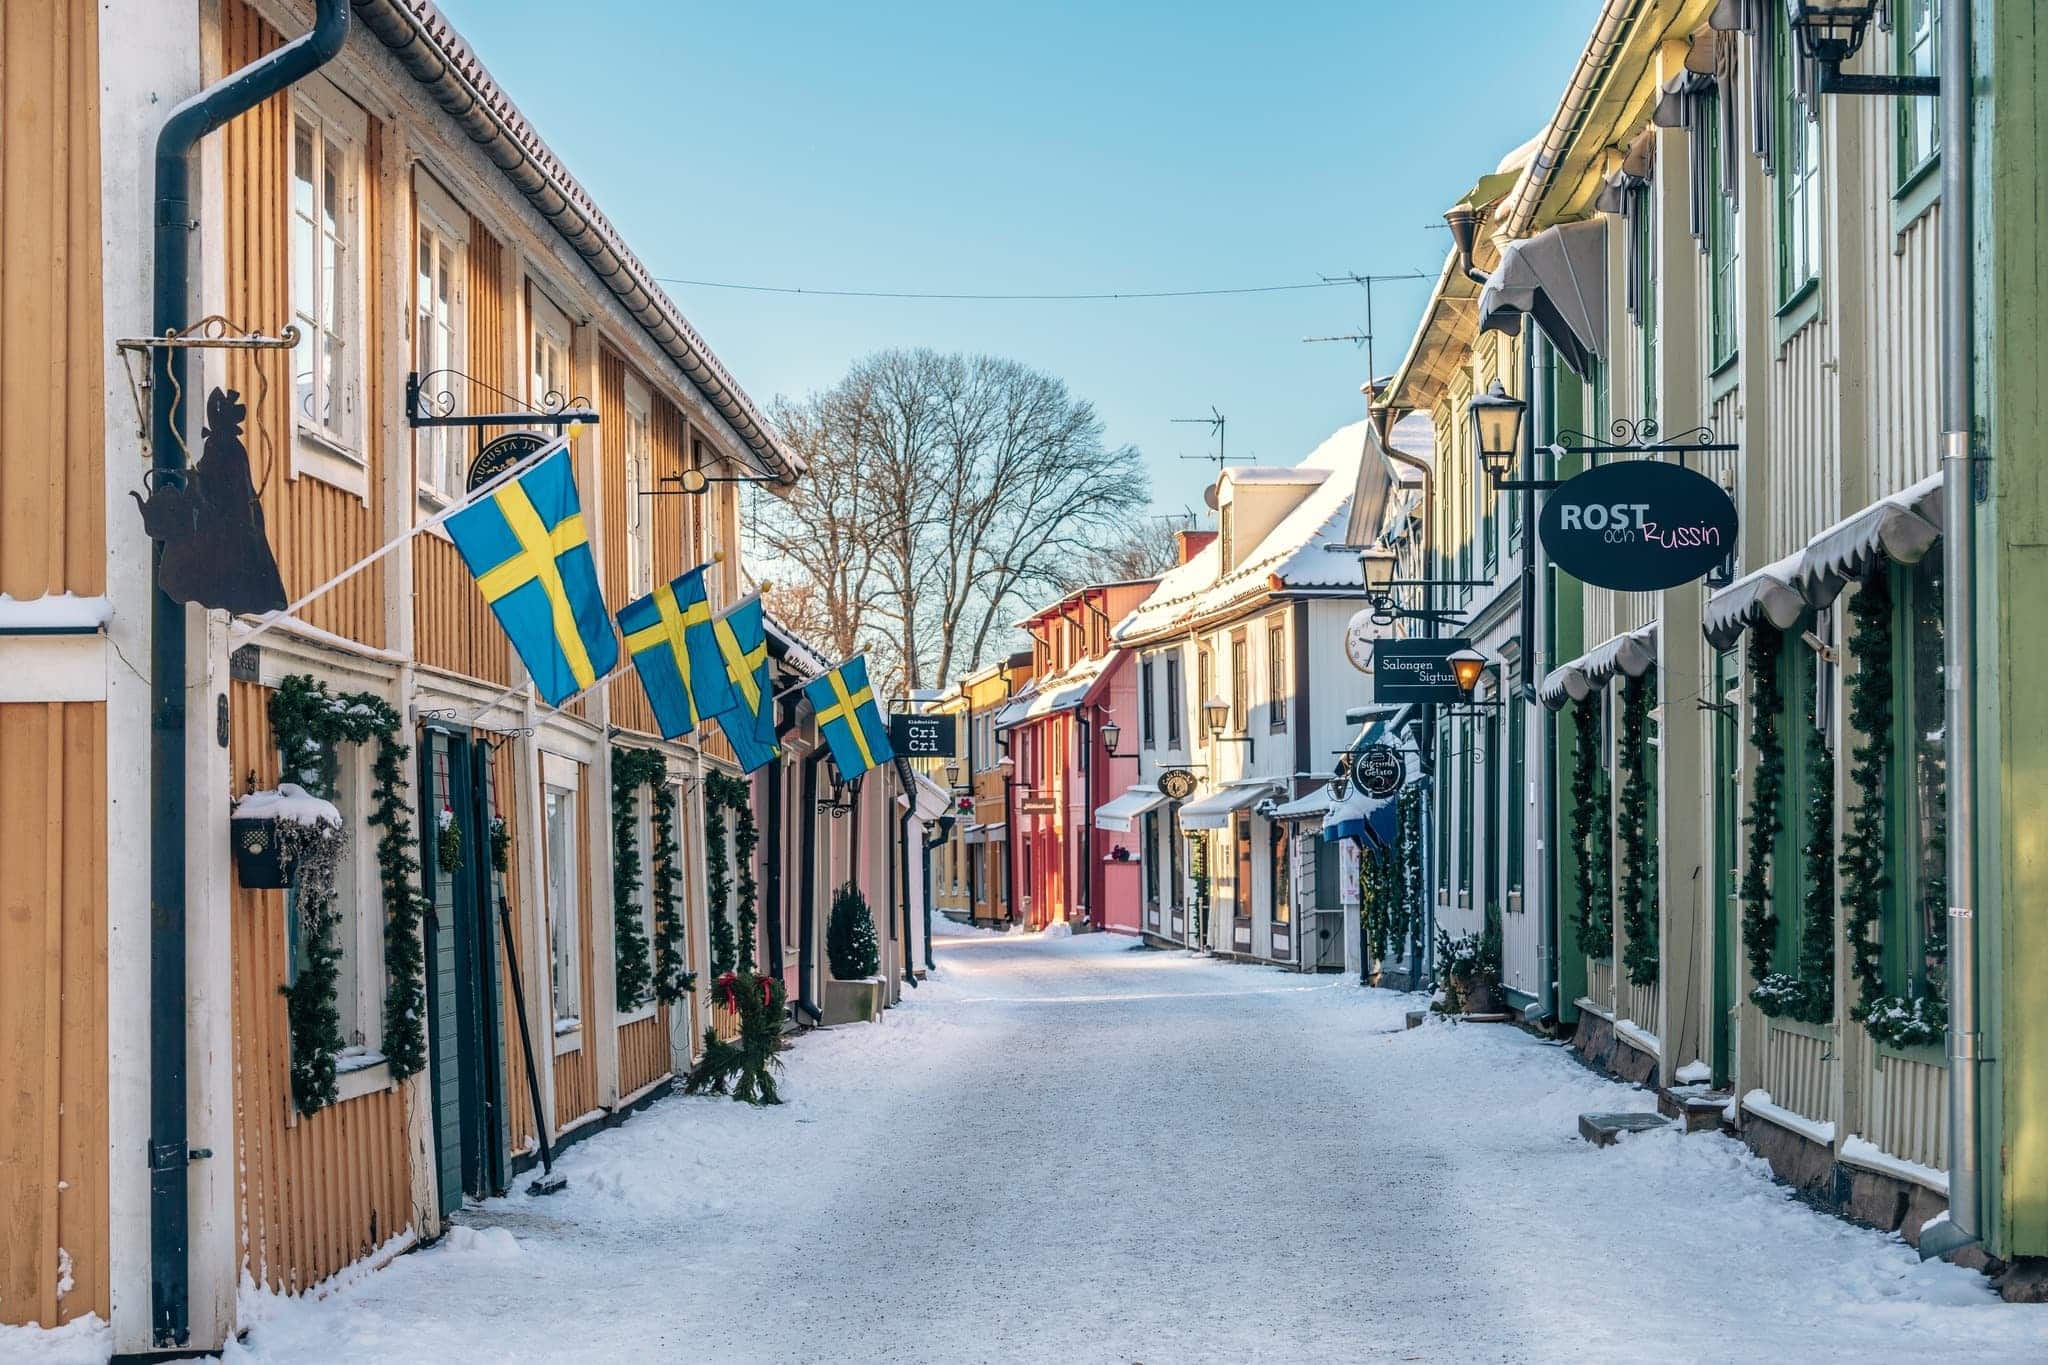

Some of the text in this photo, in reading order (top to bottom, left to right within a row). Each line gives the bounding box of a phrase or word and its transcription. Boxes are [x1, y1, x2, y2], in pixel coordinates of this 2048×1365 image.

[475, 440, 536, 483] AUGUSTA JA
[1560, 503, 1650, 531] ROST
[1604, 520, 1720, 549] och Russin
[1382, 658, 1433, 673] Salongen
[1419, 670, 1455, 685] Sigtun
[908, 726, 939, 738] Cri
[908, 739, 939, 752] Cri
